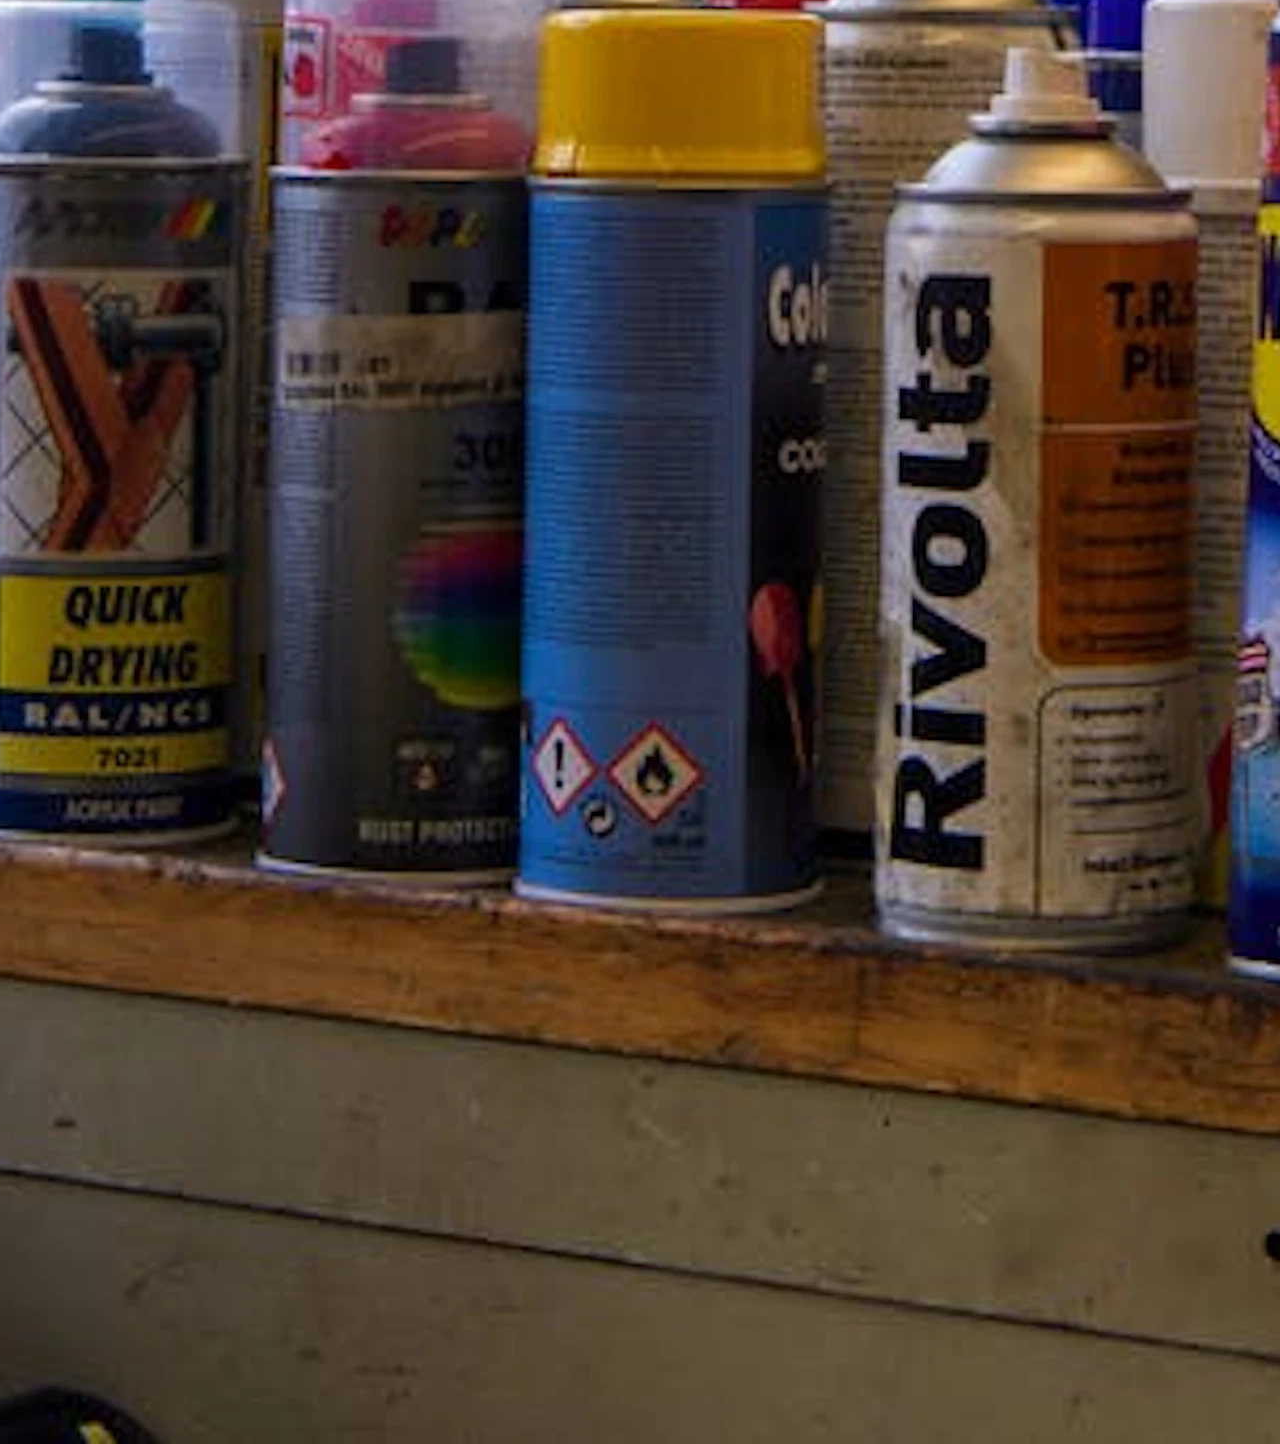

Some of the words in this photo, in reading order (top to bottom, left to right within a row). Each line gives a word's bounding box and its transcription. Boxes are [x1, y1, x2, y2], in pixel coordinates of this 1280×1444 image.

[888, 271, 993, 873] Rivolta
[65, 585, 189, 630] QUICK
[48, 641, 199, 687] DRYING
[94, 745, 162, 769] 7021
